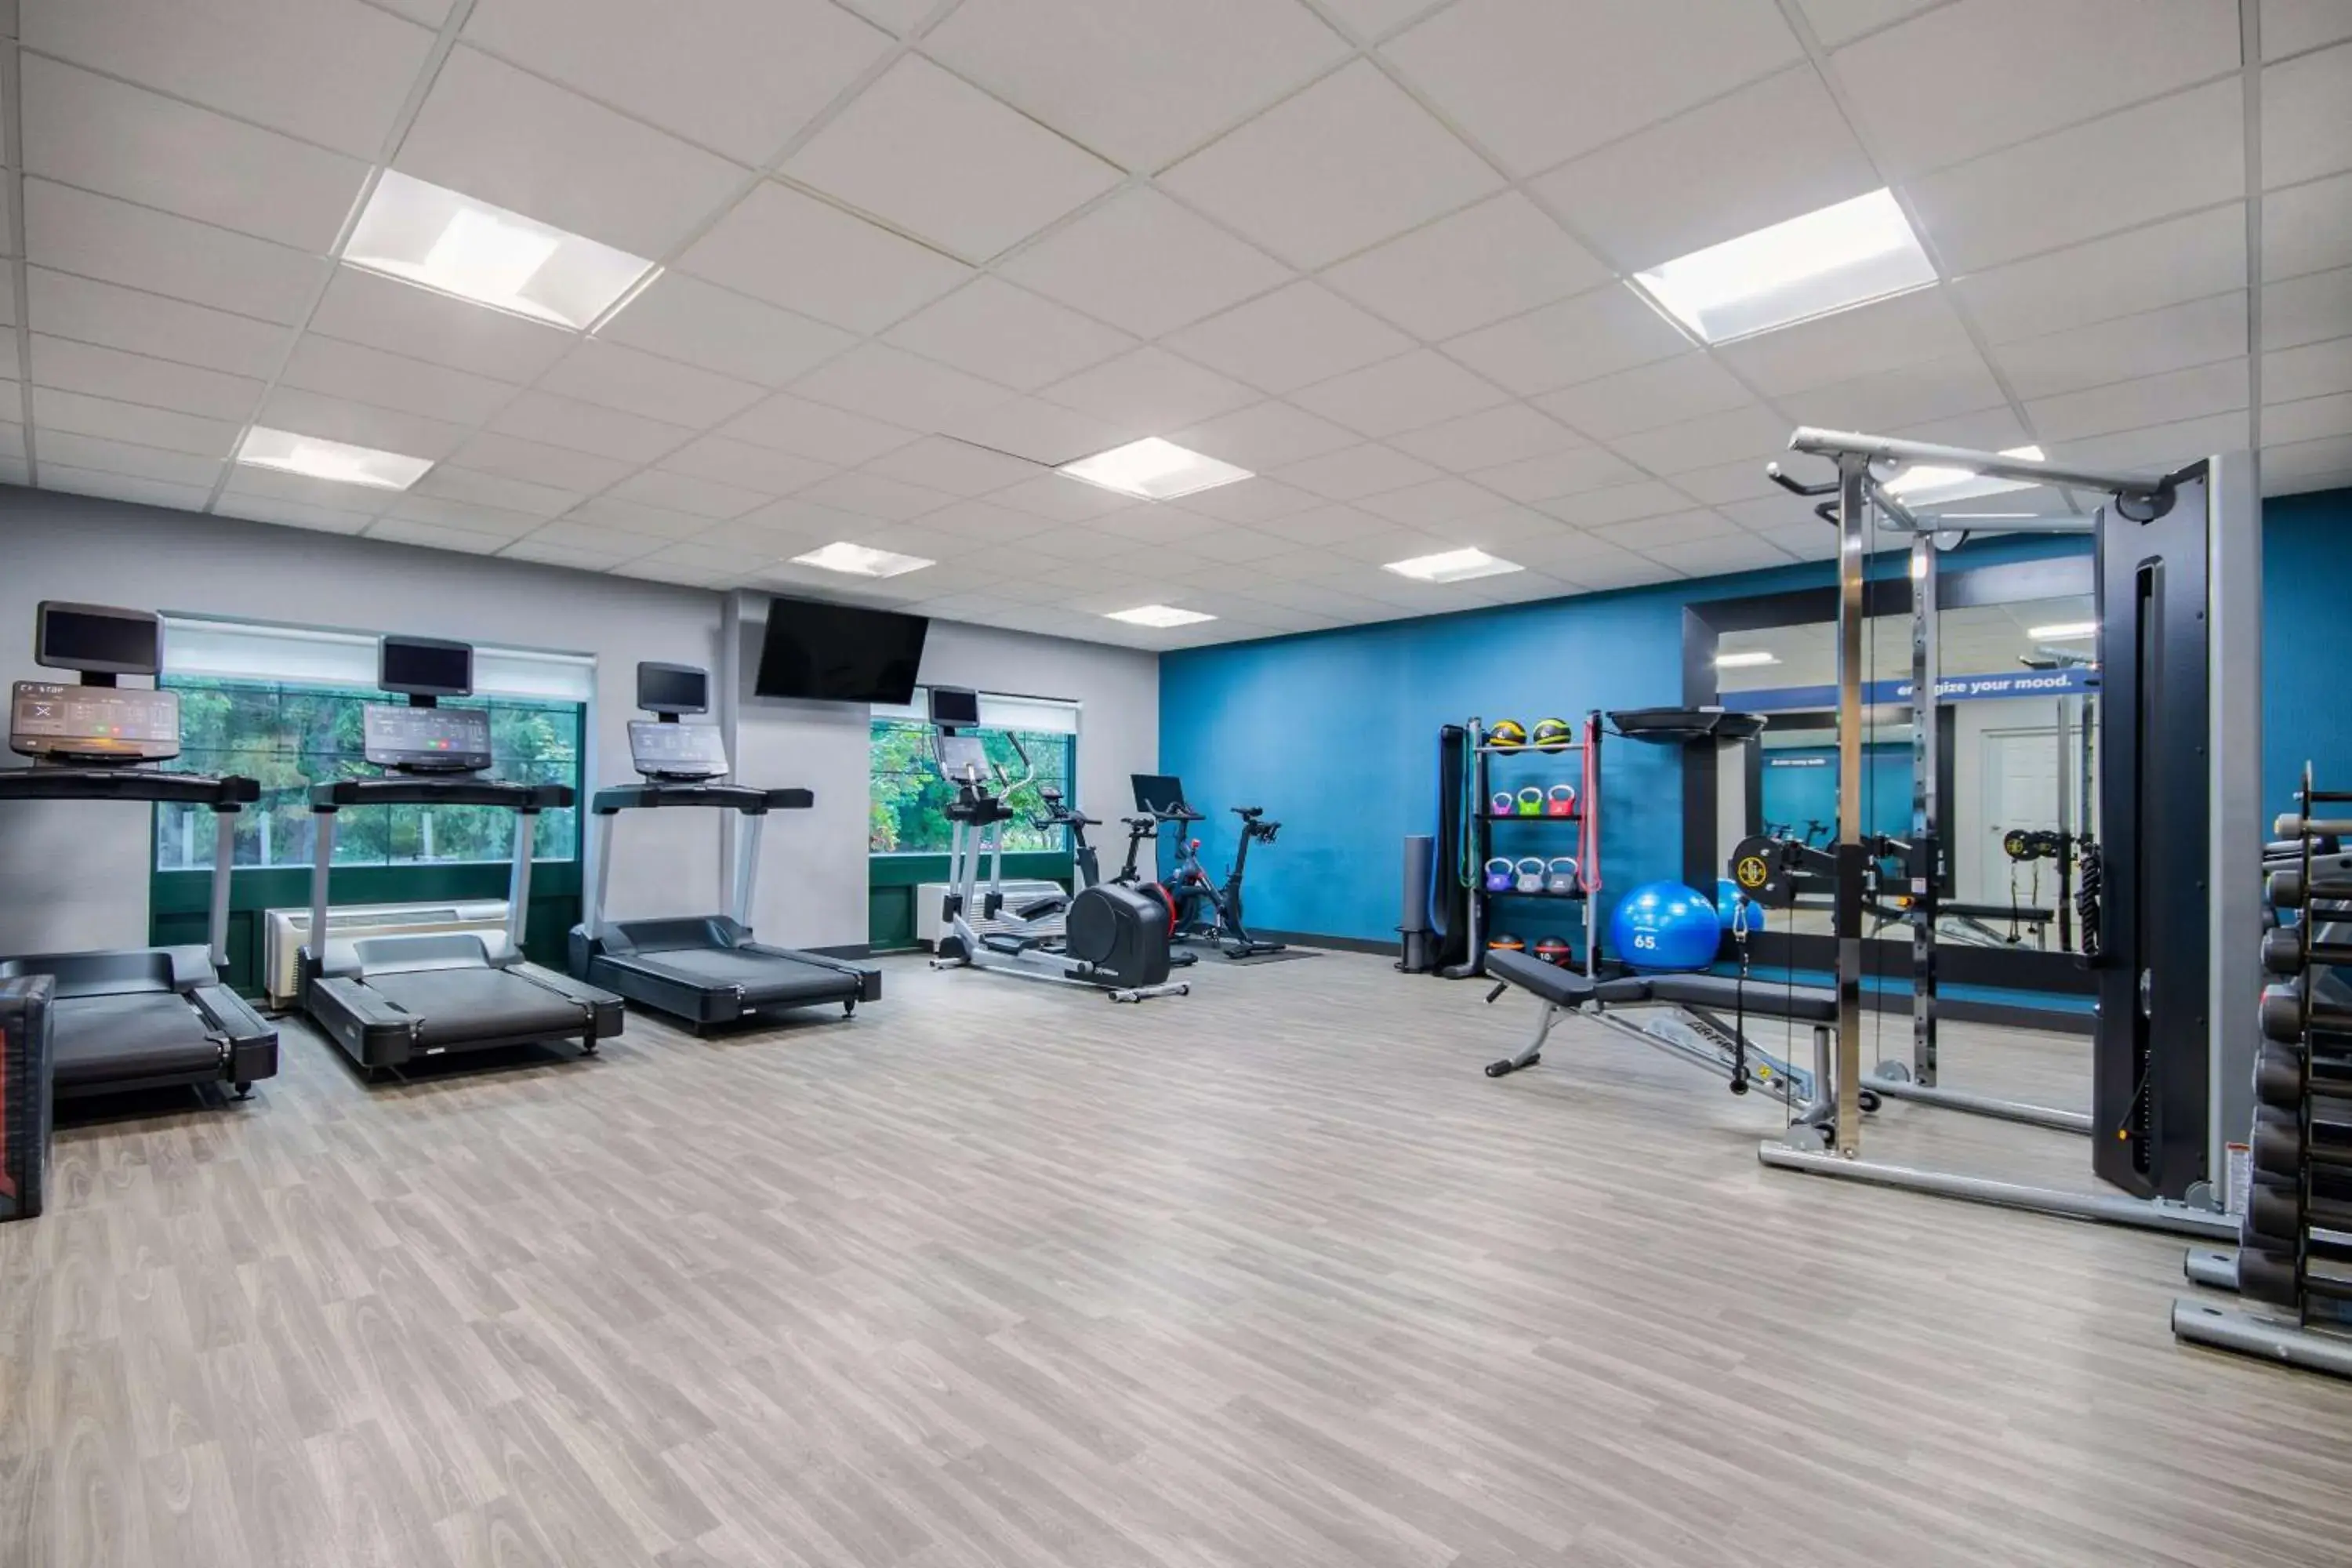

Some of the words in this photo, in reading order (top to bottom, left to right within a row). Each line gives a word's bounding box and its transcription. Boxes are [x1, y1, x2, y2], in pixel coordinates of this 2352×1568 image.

[1896, 681, 1966, 697] engize
[1970, 680, 2010, 695] your
[2015, 675, 2072, 690] mood.
[1634, 935, 1656, 949] 65
